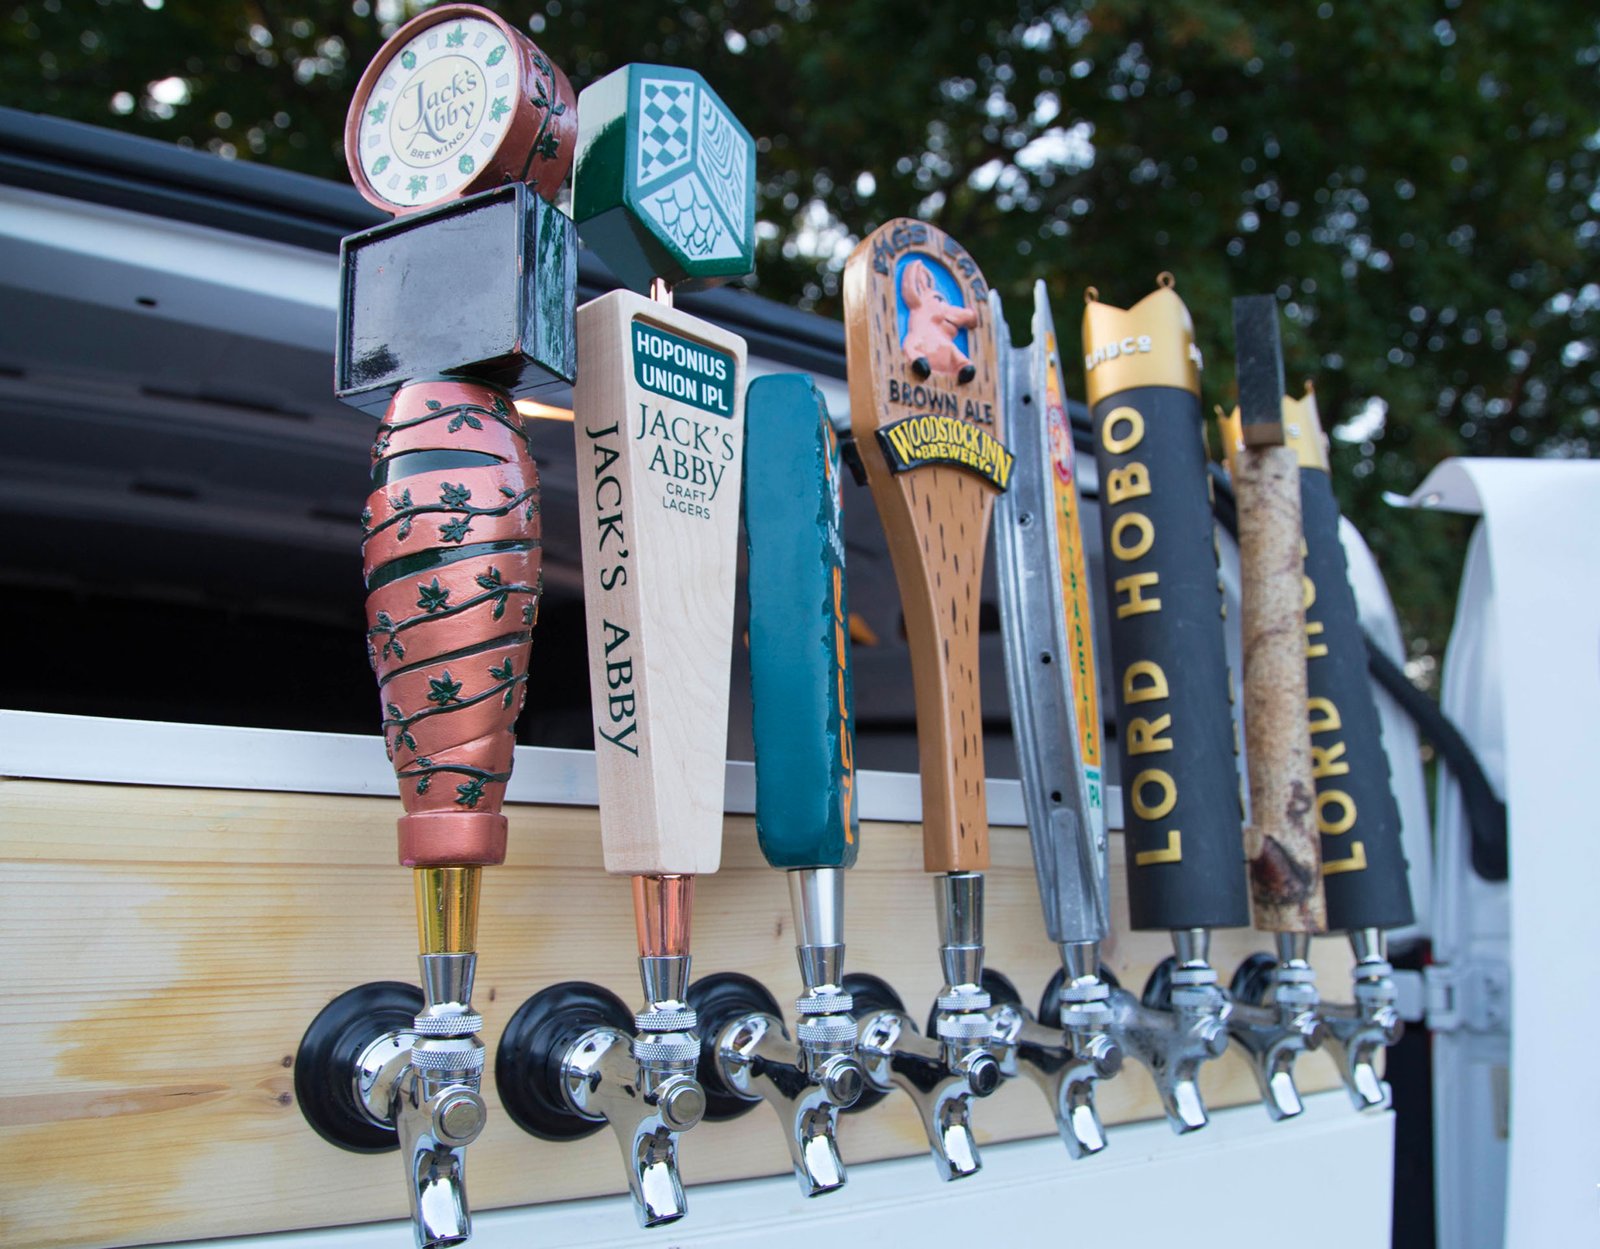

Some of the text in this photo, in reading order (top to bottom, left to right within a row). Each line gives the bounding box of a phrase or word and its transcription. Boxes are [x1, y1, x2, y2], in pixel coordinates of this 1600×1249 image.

[398, 70, 477, 131] Jack's
[406, 101, 475, 150] Abby
[410, 131, 465, 159] BREWING
[637, 331, 727, 381] HOPONIUS
[642, 363, 728, 411] UNION IPL
[889, 379, 993, 425] BROWN ALE
[636, 403, 734, 461] JACK'S
[888, 415, 1014, 487] WOODSTOCK INN
[920, 442, 987, 471] BREWERY
[586, 421, 629, 591] JACK'S
[662, 496, 711, 520] LAGERS
[666, 482, 706, 502] CRAFT
[1101, 406, 1182, 866] LORD HOBO
[1308, 696, 1367, 875] LORD
